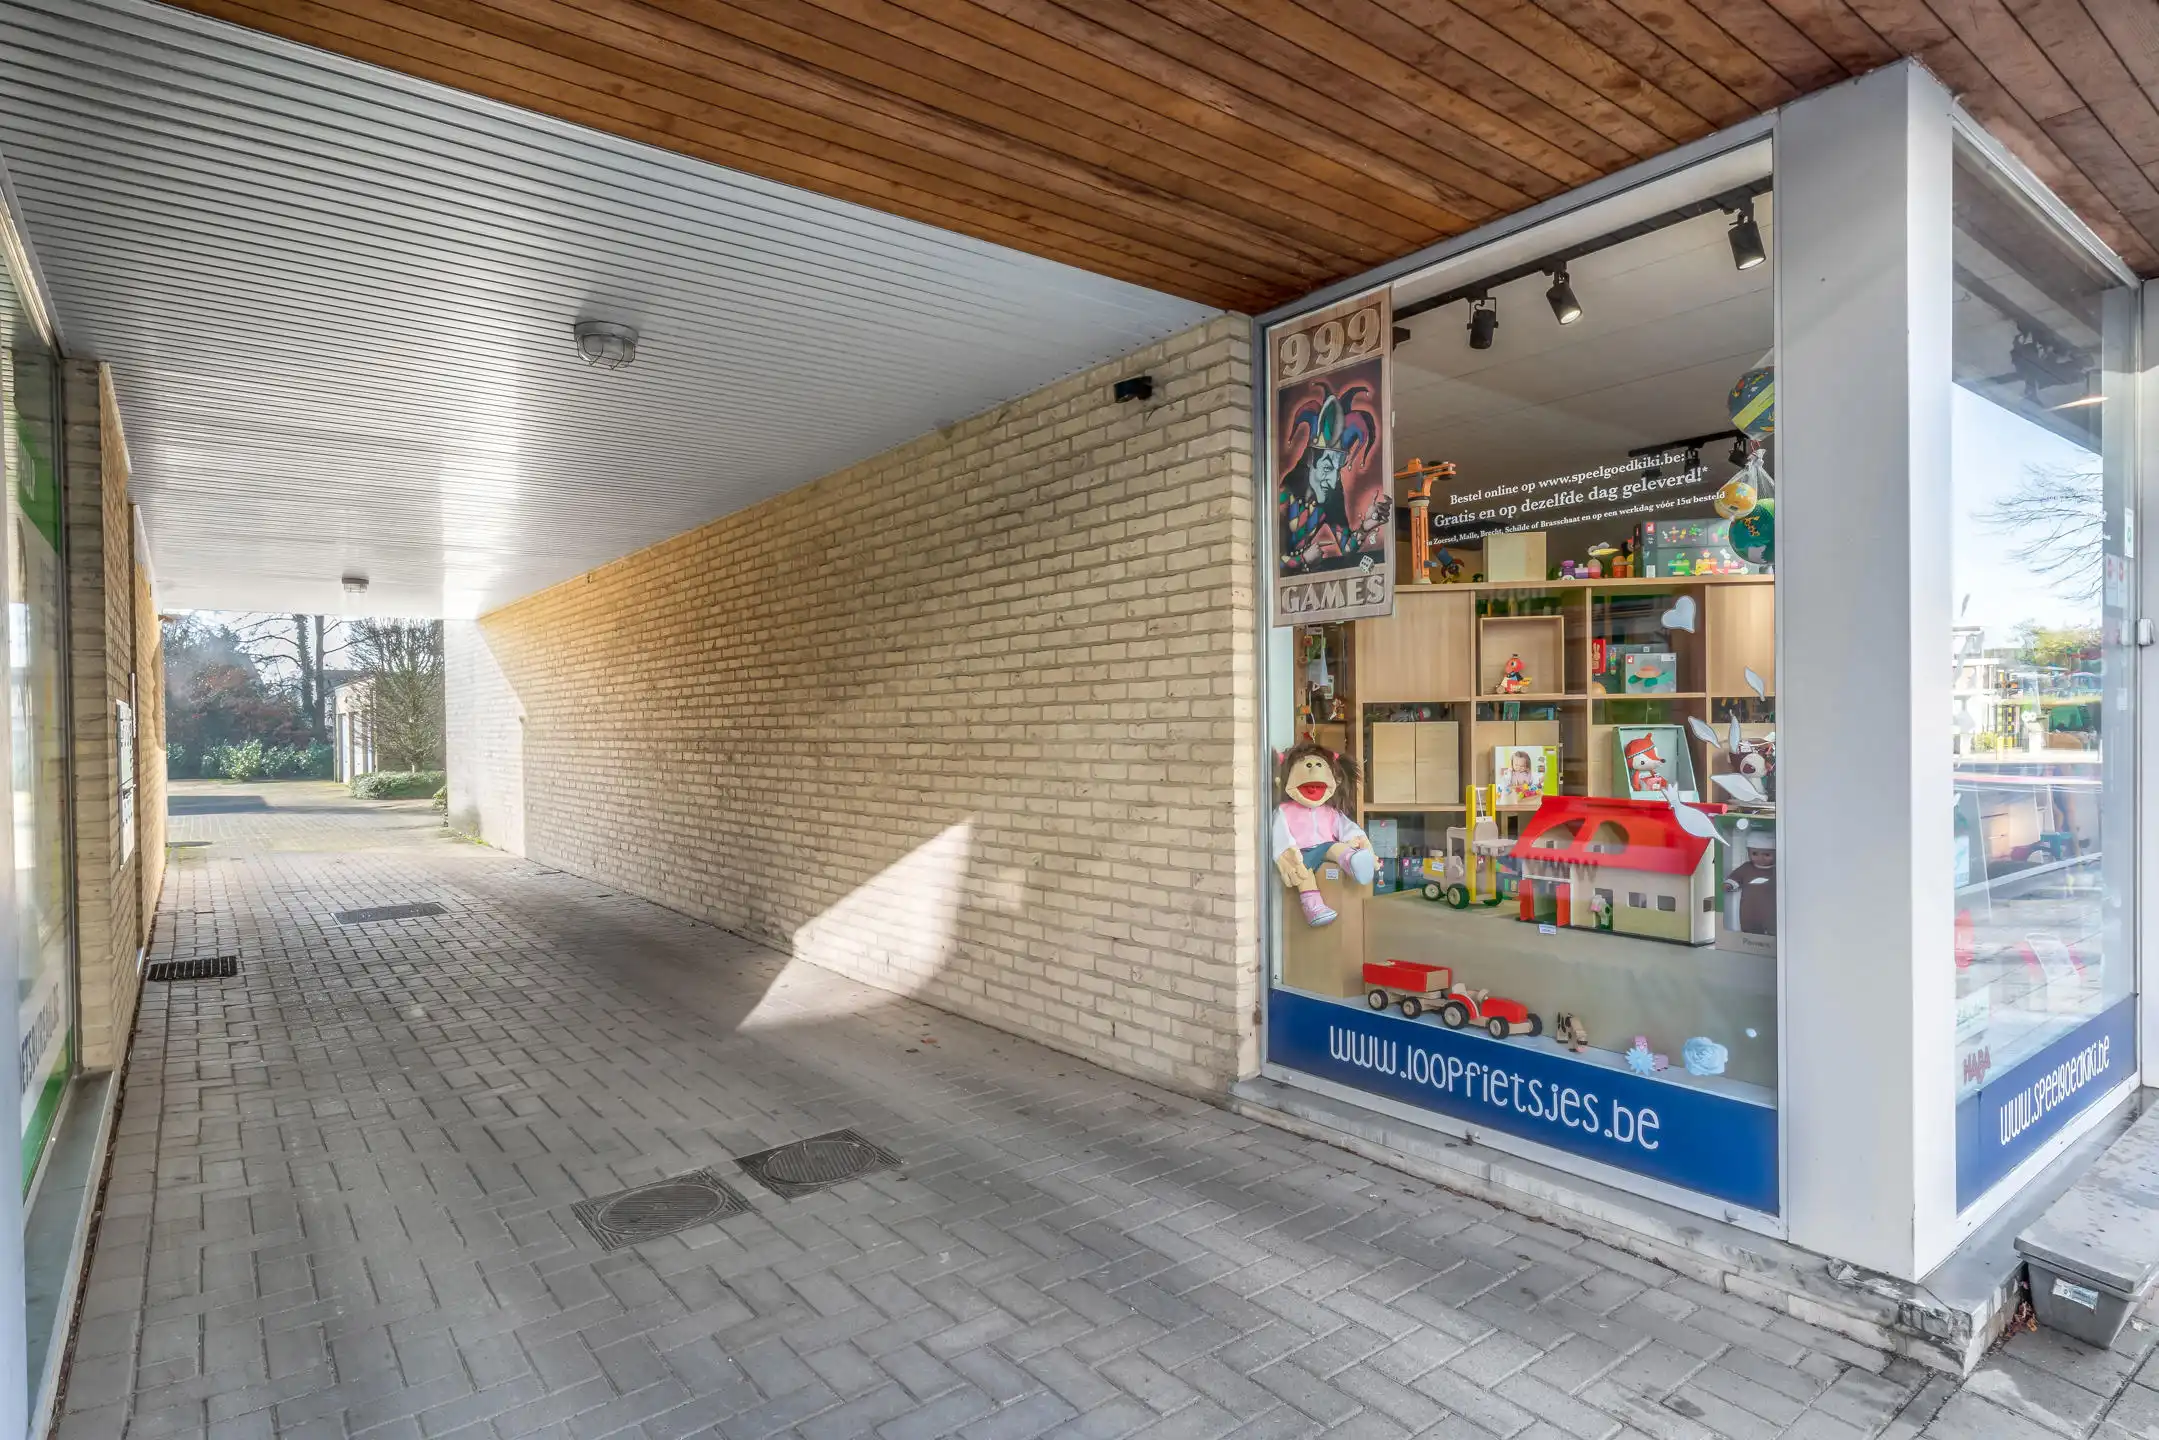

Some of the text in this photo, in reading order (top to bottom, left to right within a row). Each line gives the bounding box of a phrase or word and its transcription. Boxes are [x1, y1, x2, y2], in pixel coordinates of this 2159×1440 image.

[1281, 307, 1381, 377] 999
[1450, 452, 1685, 505] Bestel online op www.speelgoedkiki.be:
[1433, 534, 1459, 546] Zoersel,
[1459, 531, 1480, 542] Malle,
[1480, 528, 1504, 538] Brecht,
[1505, 523, 1530, 534] Schilde
[1531, 521, 1539, 529] of
[1540, 516, 1580, 528] Brasschaat
[1592, 512, 1603, 521] op
[1619, 503, 1654, 515] werkdag
[1676, 497, 1692, 506] 15u
[1693, 491, 1726, 503] besteld
[1434, 509, 1476, 527] Gratis
[1478, 508, 1496, 520] en
[1499, 504, 1518, 519] op
[1521, 490, 1584, 513] dezelfde
[1588, 486, 1619, 501] dag
[1281, 574, 1385, 614] GAMES
[1329, 1024, 1660, 1151] www.loopfietsjes.be
[2000, 1034, 2110, 1147] www.speelgoedkiki.be
